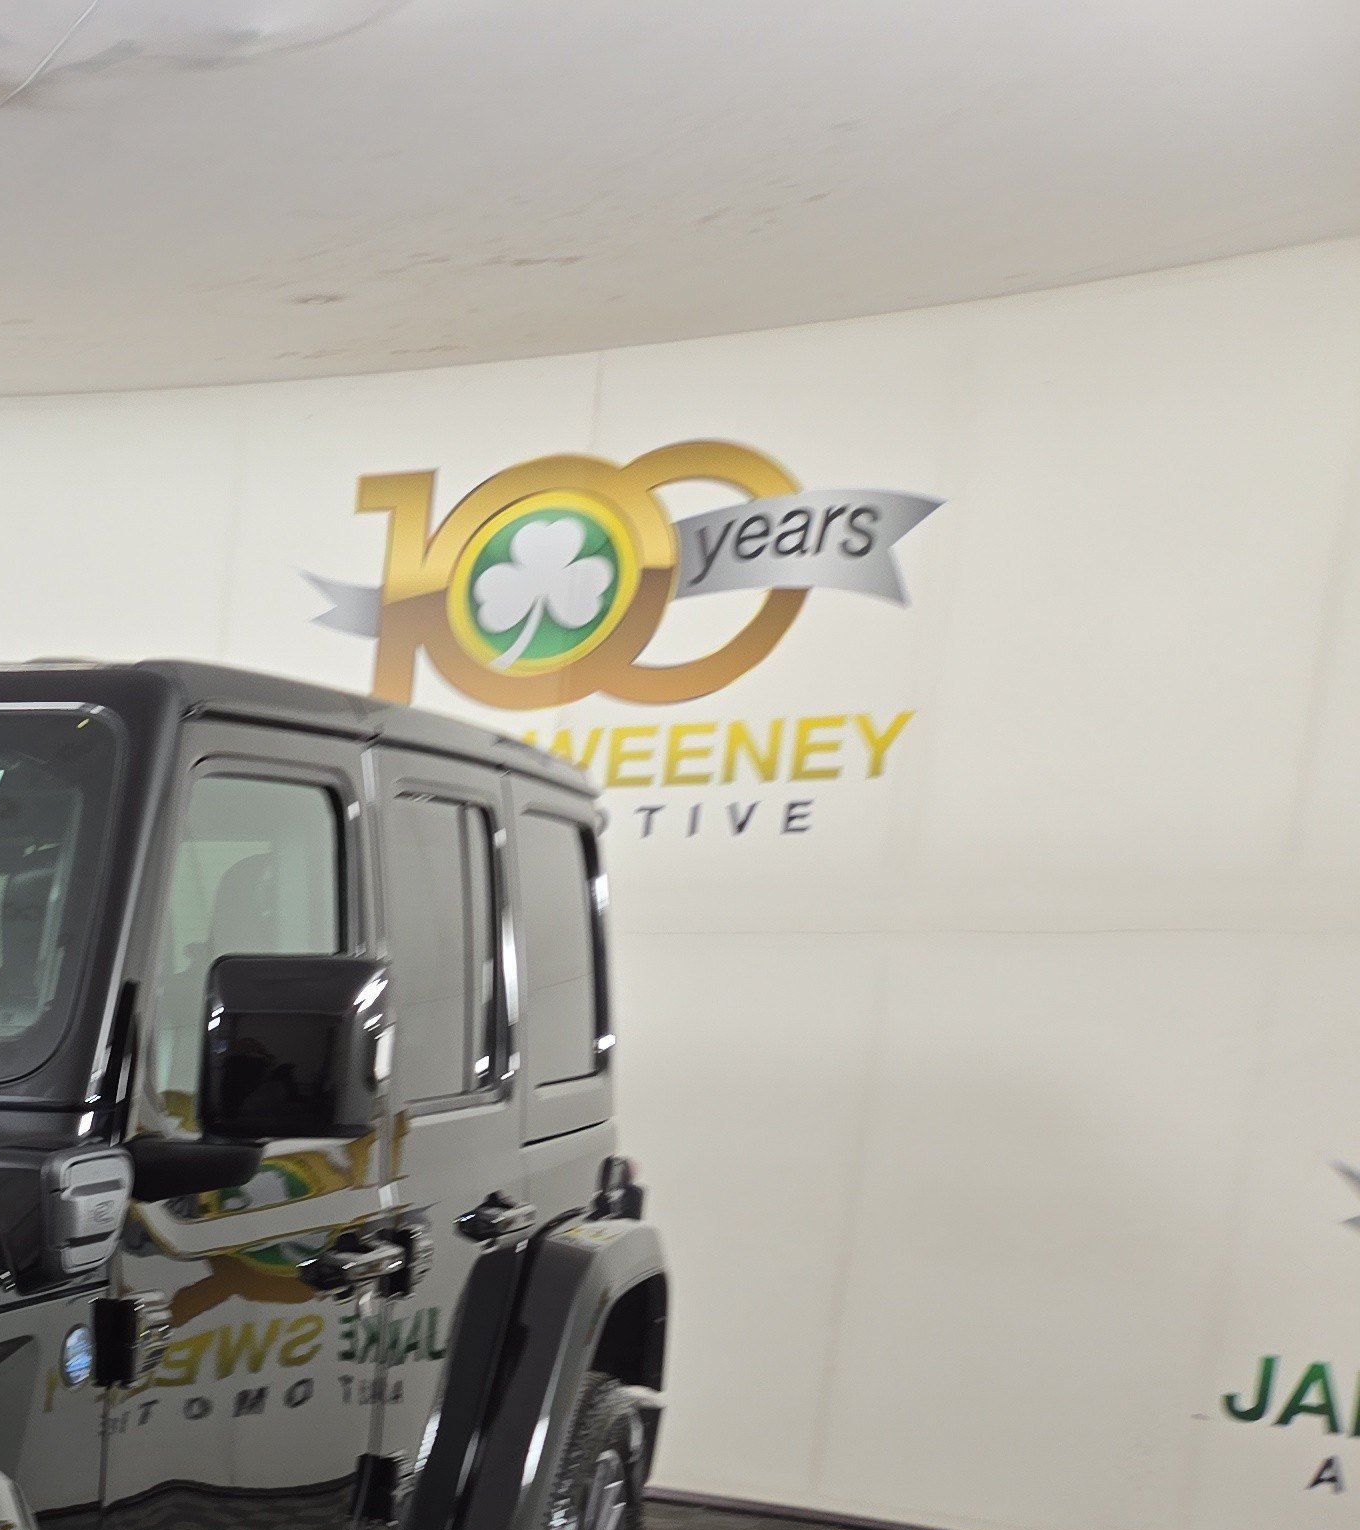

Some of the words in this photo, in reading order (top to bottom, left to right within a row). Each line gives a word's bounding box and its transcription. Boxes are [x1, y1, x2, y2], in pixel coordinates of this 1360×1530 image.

[354, 437, 811, 711] 100
[688, 499, 882, 587] years
[520, 709, 916, 790] EENEY
[1220, 1354, 1360, 1438] JA
